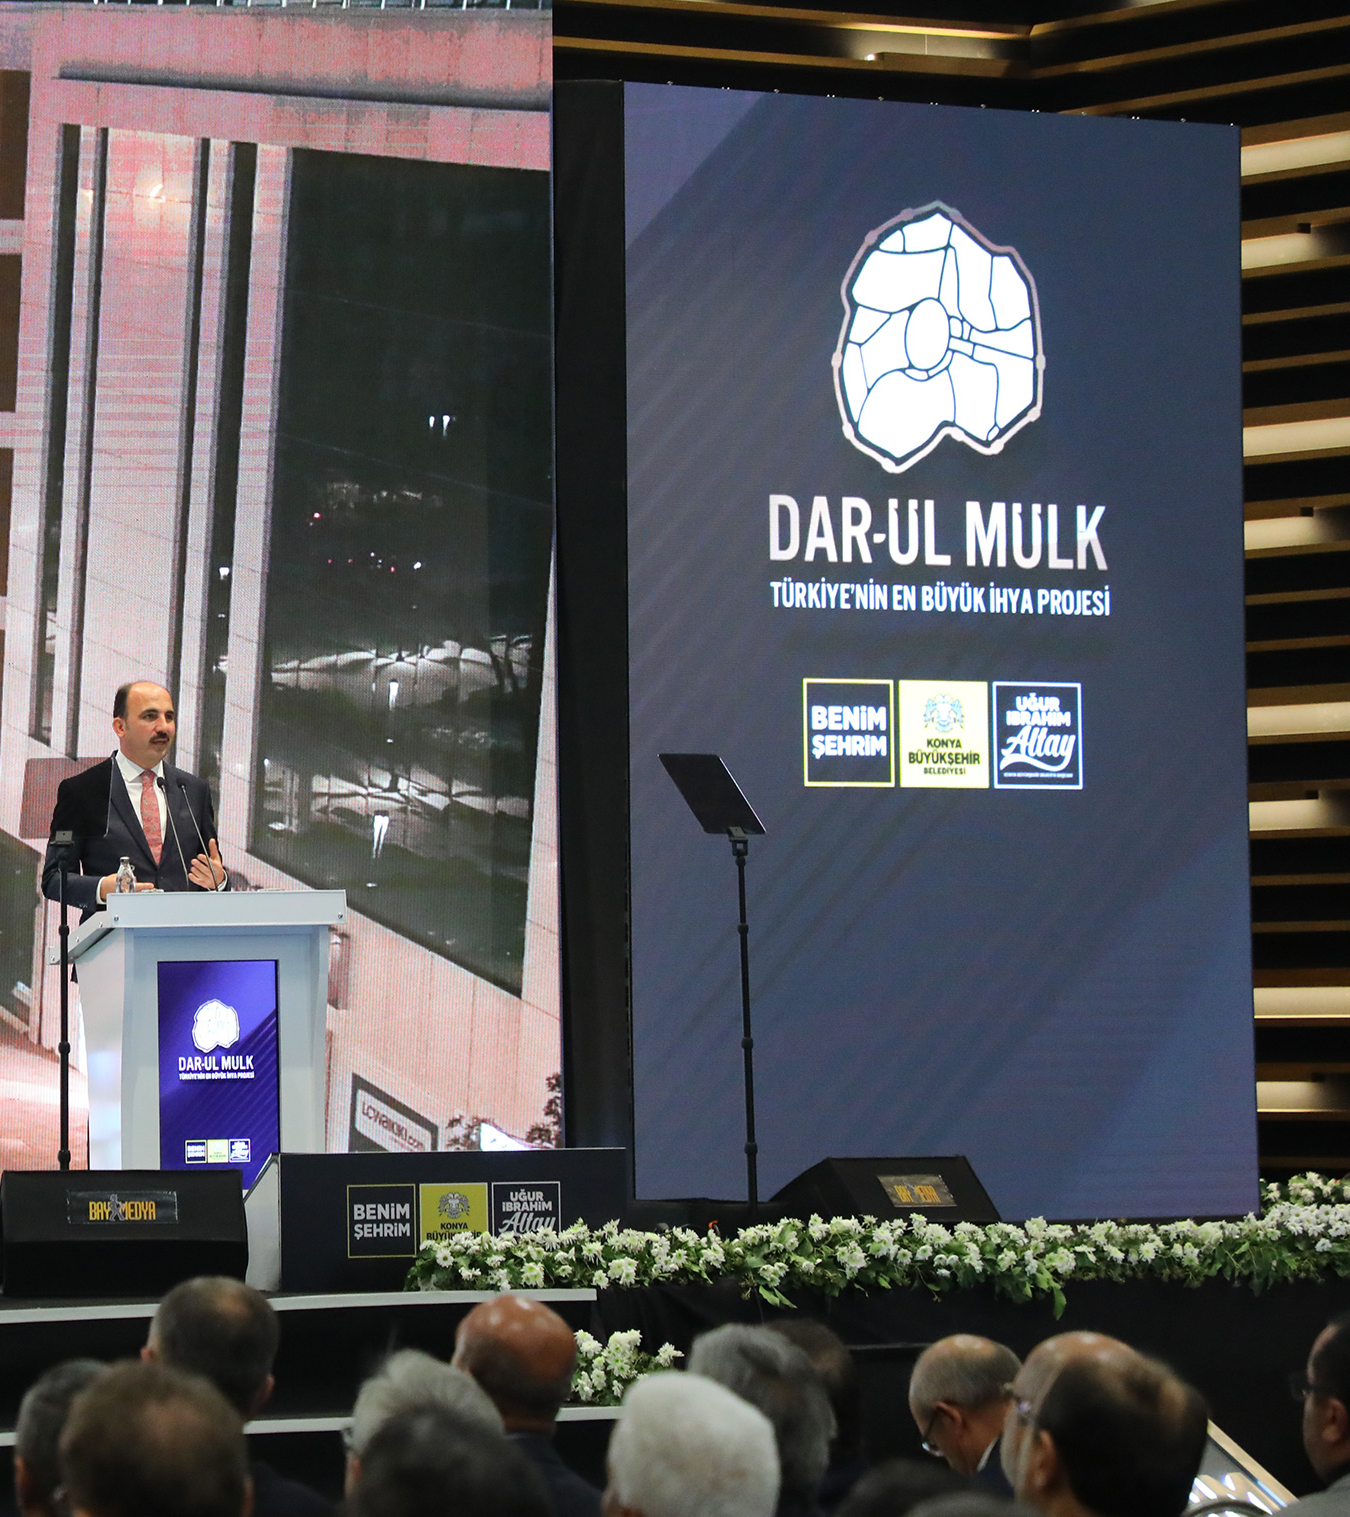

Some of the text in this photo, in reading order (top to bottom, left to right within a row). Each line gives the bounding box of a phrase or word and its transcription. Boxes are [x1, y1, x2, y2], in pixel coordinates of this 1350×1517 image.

[769, 577, 1111, 616] TÜRKİYE'NİN EN BÜYÜK İHYA PROJESİ
[1015, 692, 1061, 712] UĞUR
[926, 738, 962, 749] KONYA
[999, 725, 1077, 772] Altay
[908, 749, 981, 767] BÜYÜKŞEHİR
[221, 1055, 254, 1071] MULK
[509, 1188, 544, 1202] UĞUR
[440, 1222, 469, 1230] KONYA
